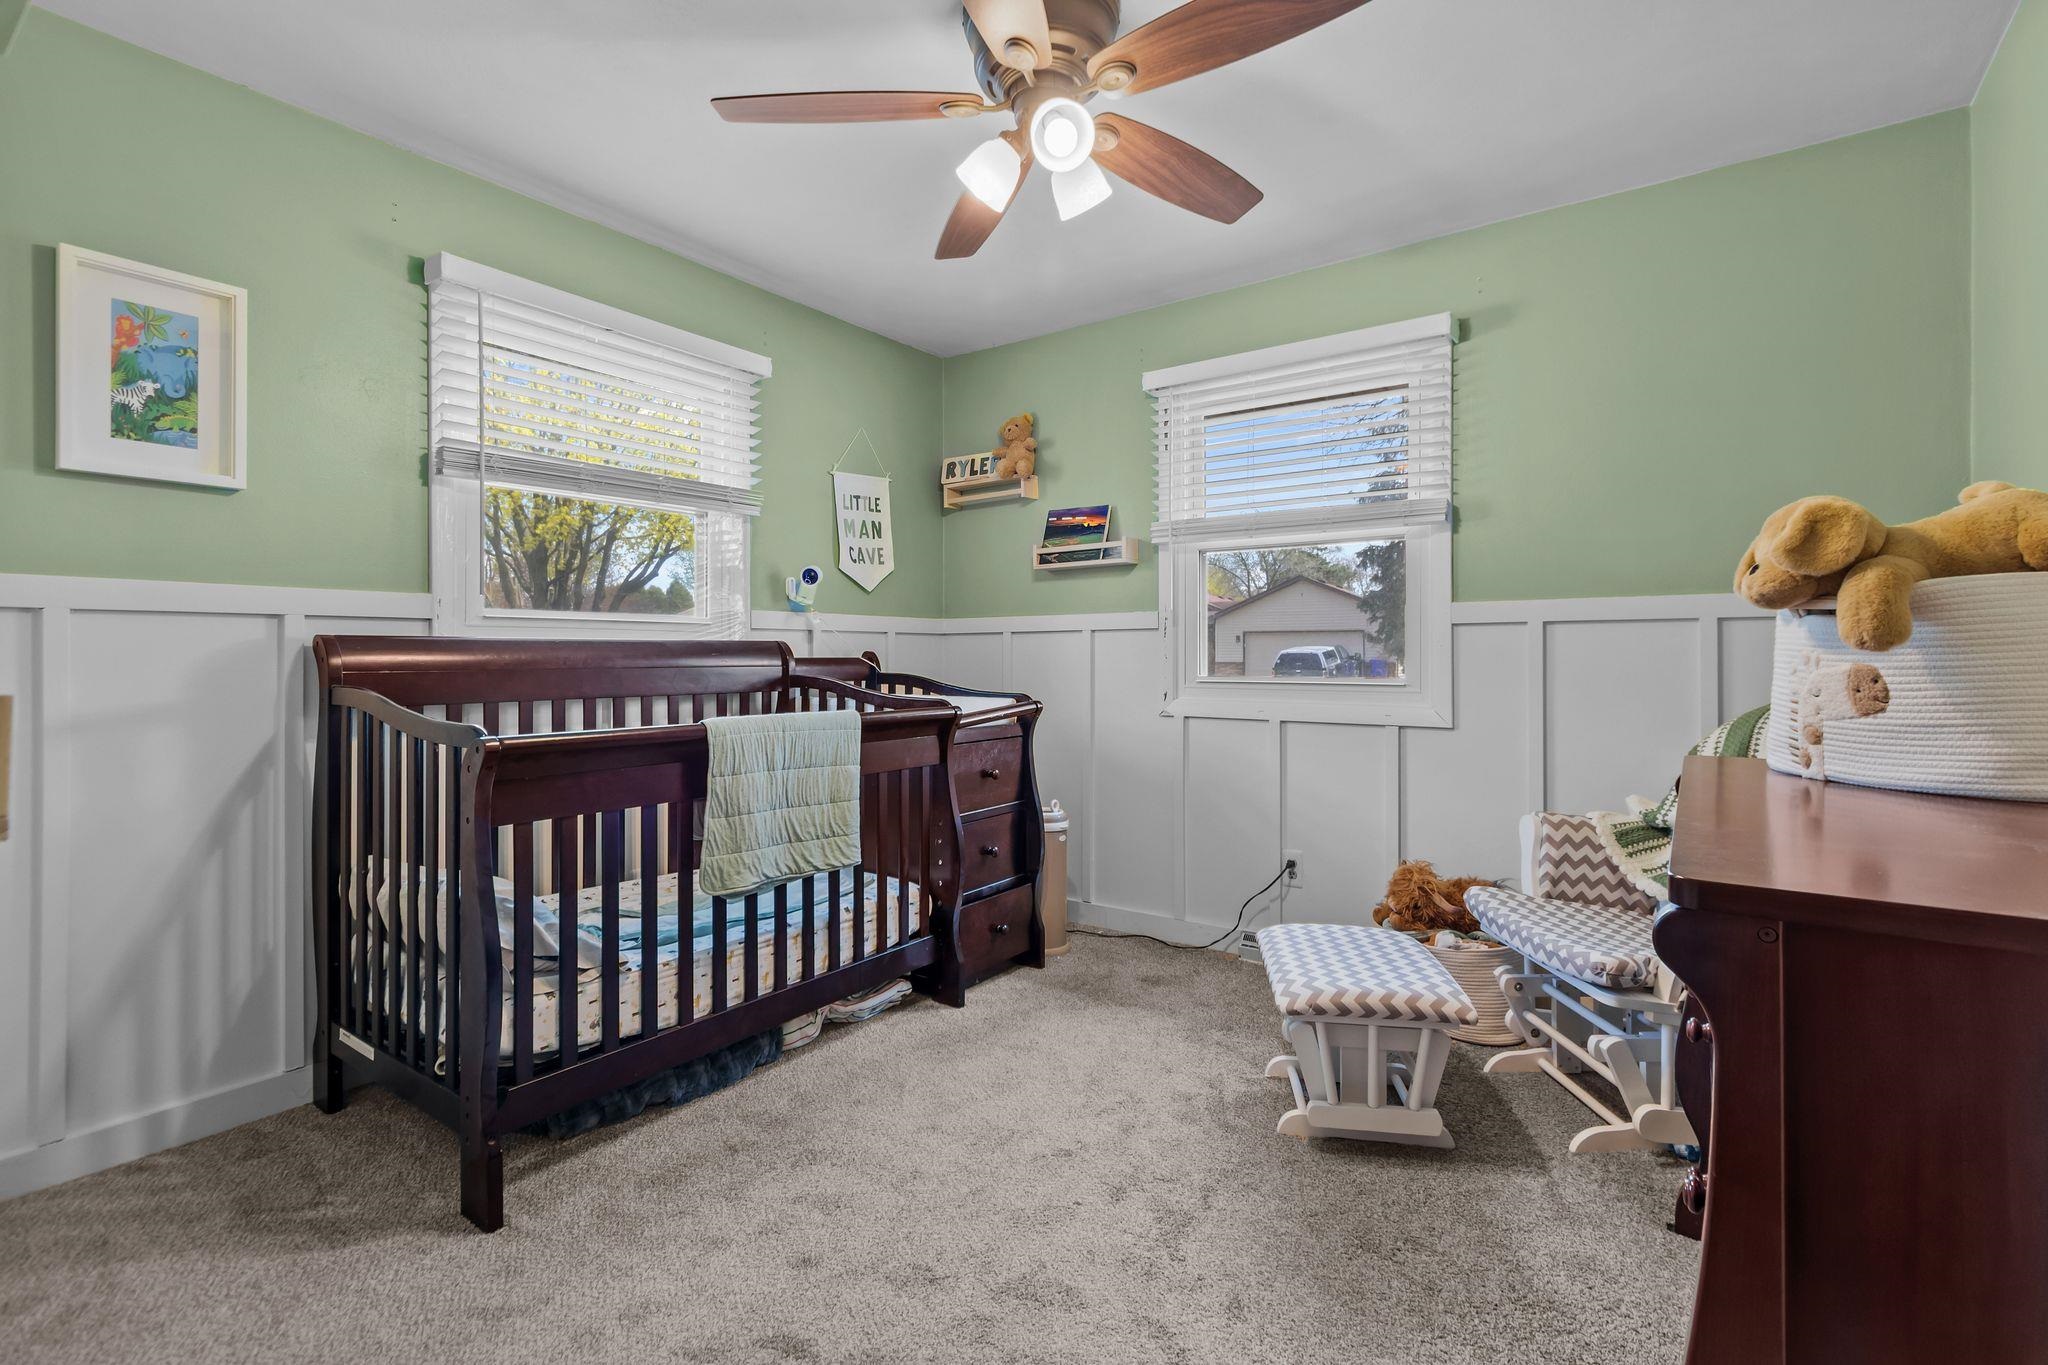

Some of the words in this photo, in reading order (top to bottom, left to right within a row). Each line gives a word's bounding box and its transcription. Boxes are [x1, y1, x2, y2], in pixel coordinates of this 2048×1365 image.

[842, 493, 882, 513] LITTLE
[843, 518, 882, 540] MAN
[849, 546, 885, 565] CAVE
